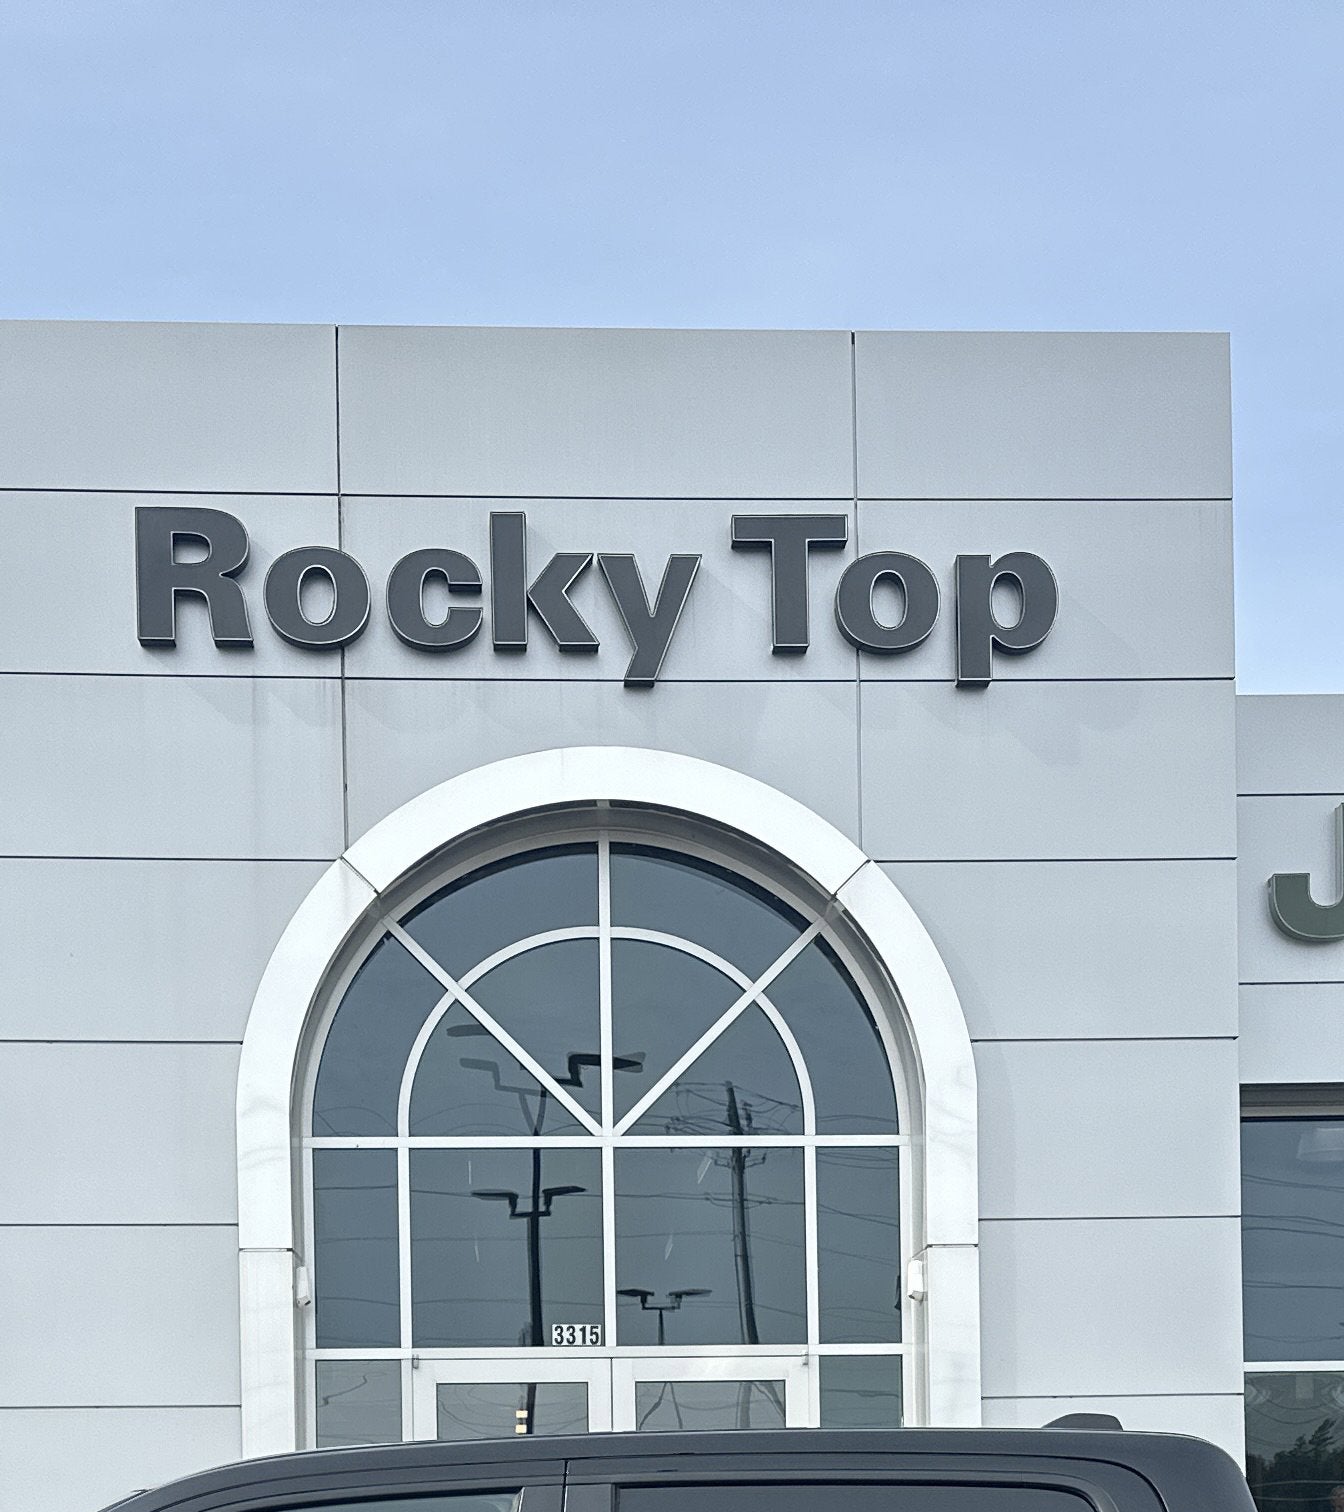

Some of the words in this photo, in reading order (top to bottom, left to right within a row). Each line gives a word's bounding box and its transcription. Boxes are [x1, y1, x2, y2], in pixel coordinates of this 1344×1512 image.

[135, 506, 700, 688] Rocky
[730, 512, 1059, 690] Top
[554, 1325, 600, 1345] 3315
